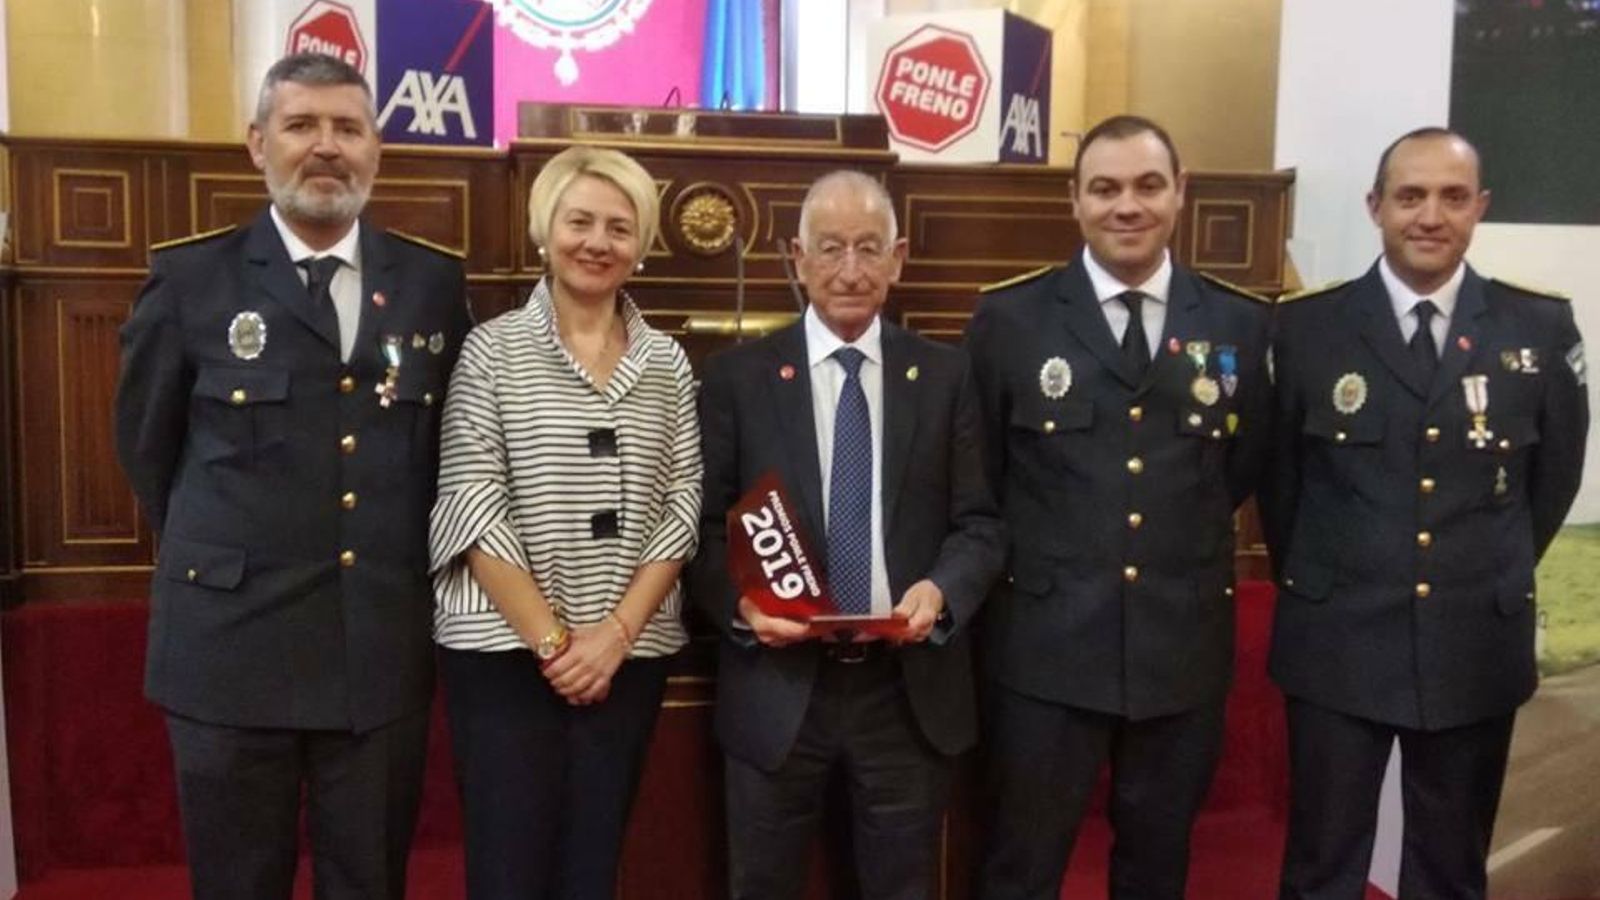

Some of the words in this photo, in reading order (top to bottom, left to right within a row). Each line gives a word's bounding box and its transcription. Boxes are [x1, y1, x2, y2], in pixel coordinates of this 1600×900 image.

[376, 69, 477, 139] AXA
[889, 80, 970, 122] FRENO
[896, 57, 977, 98] PONLE
[999, 93, 1042, 158] AXA
[741, 506, 805, 600] 2019
[786, 532, 807, 566] PONLE
[800, 564, 822, 598] FRENO
